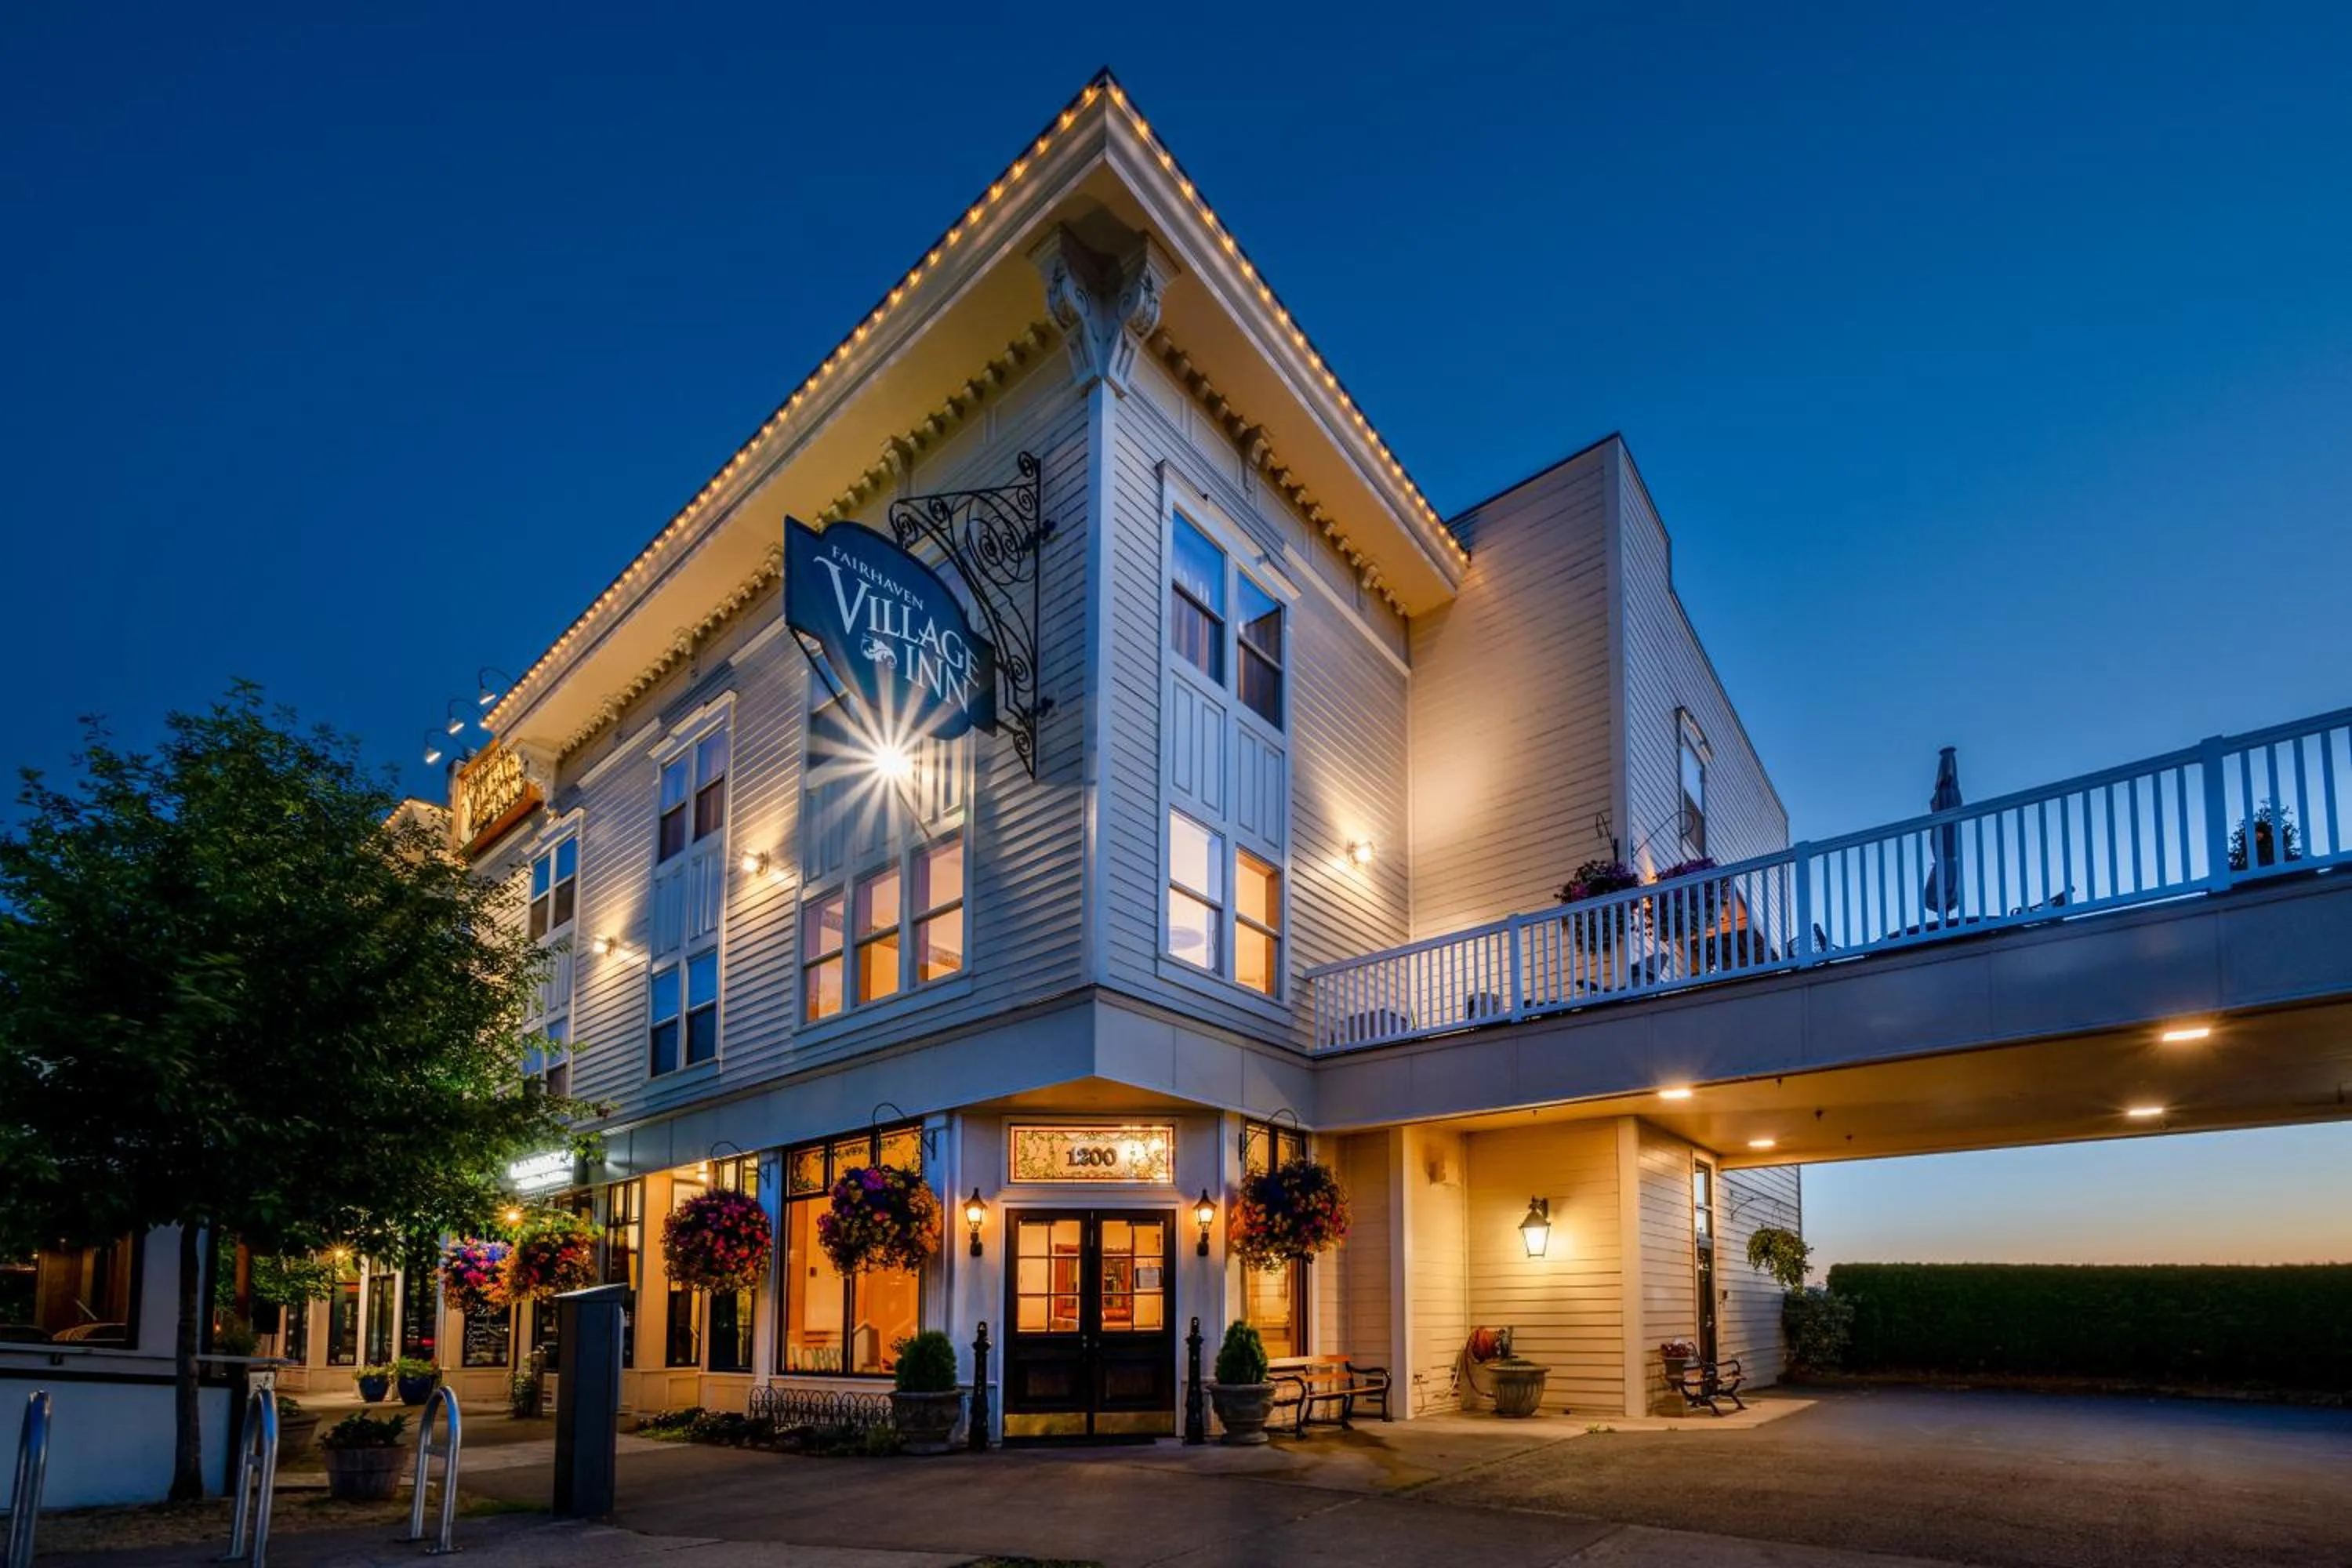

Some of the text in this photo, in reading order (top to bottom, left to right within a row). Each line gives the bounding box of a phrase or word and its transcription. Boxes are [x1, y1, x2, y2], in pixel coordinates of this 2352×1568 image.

[831, 546, 924, 610] FAIRHAVEN
[813, 556, 978, 688] VILLAGE
[905, 644, 970, 713] INN
[1065, 1147, 1117, 1167] 1200
